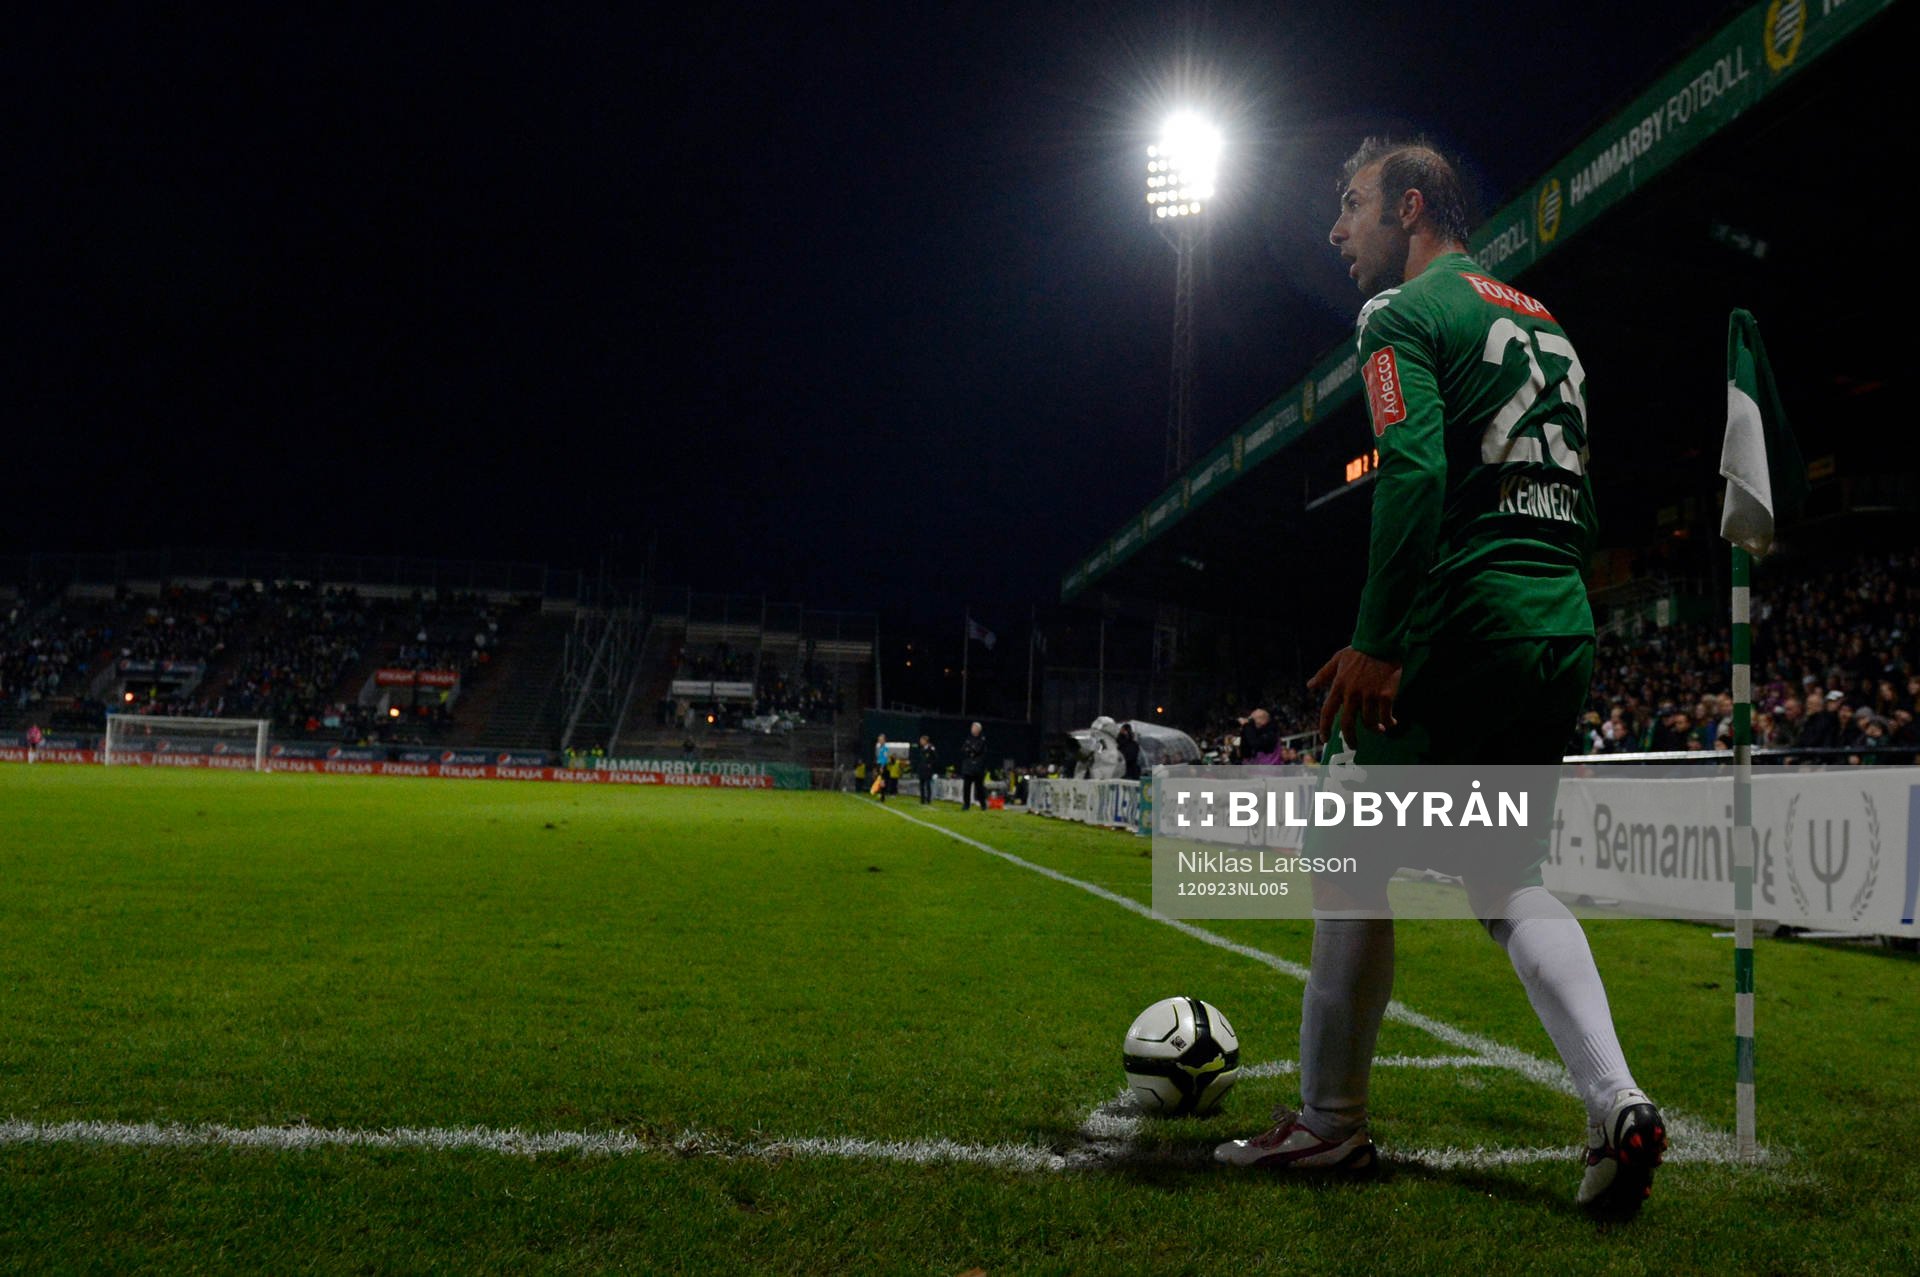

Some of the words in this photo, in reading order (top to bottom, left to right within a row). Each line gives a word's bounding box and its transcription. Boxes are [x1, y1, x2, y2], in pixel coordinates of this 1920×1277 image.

[1570, 105, 1665, 207] HAMMARBY
[1667, 45, 1750, 133] FOTBOLL
[1377, 353, 1400, 416] Adecco
[1481, 317, 1590, 477] 23
[595, 757, 696, 775] HAMMARBY
[701, 761, 767, 777] FOTBOLL
